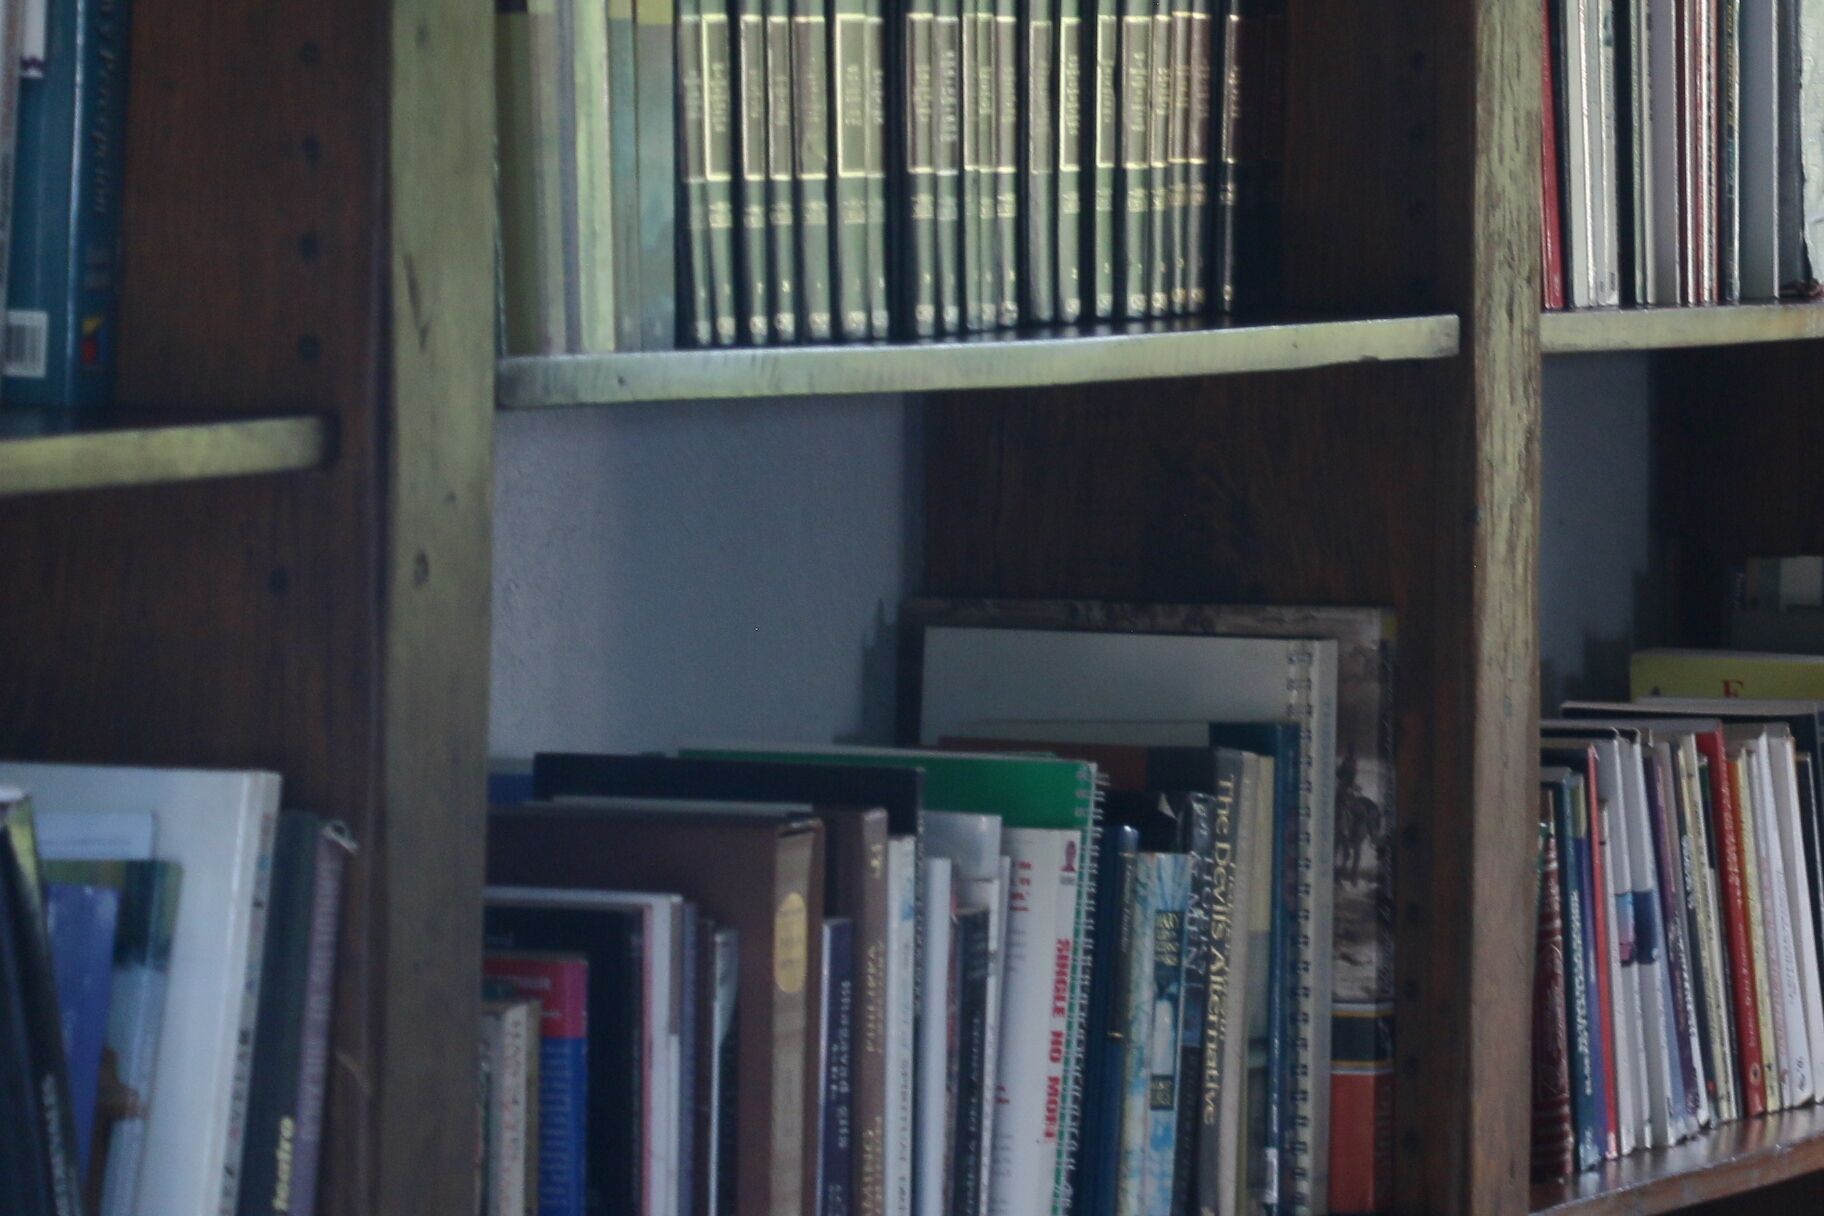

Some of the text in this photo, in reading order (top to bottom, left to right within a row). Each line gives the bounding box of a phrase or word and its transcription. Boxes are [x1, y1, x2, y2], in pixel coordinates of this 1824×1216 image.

[1215, 774, 1235, 835] The
[1052, 938, 1071, 1018] SINGLE
[1049, 1030, 1064, 1064] NO
[1203, 945, 1226, 1127] Alternative
